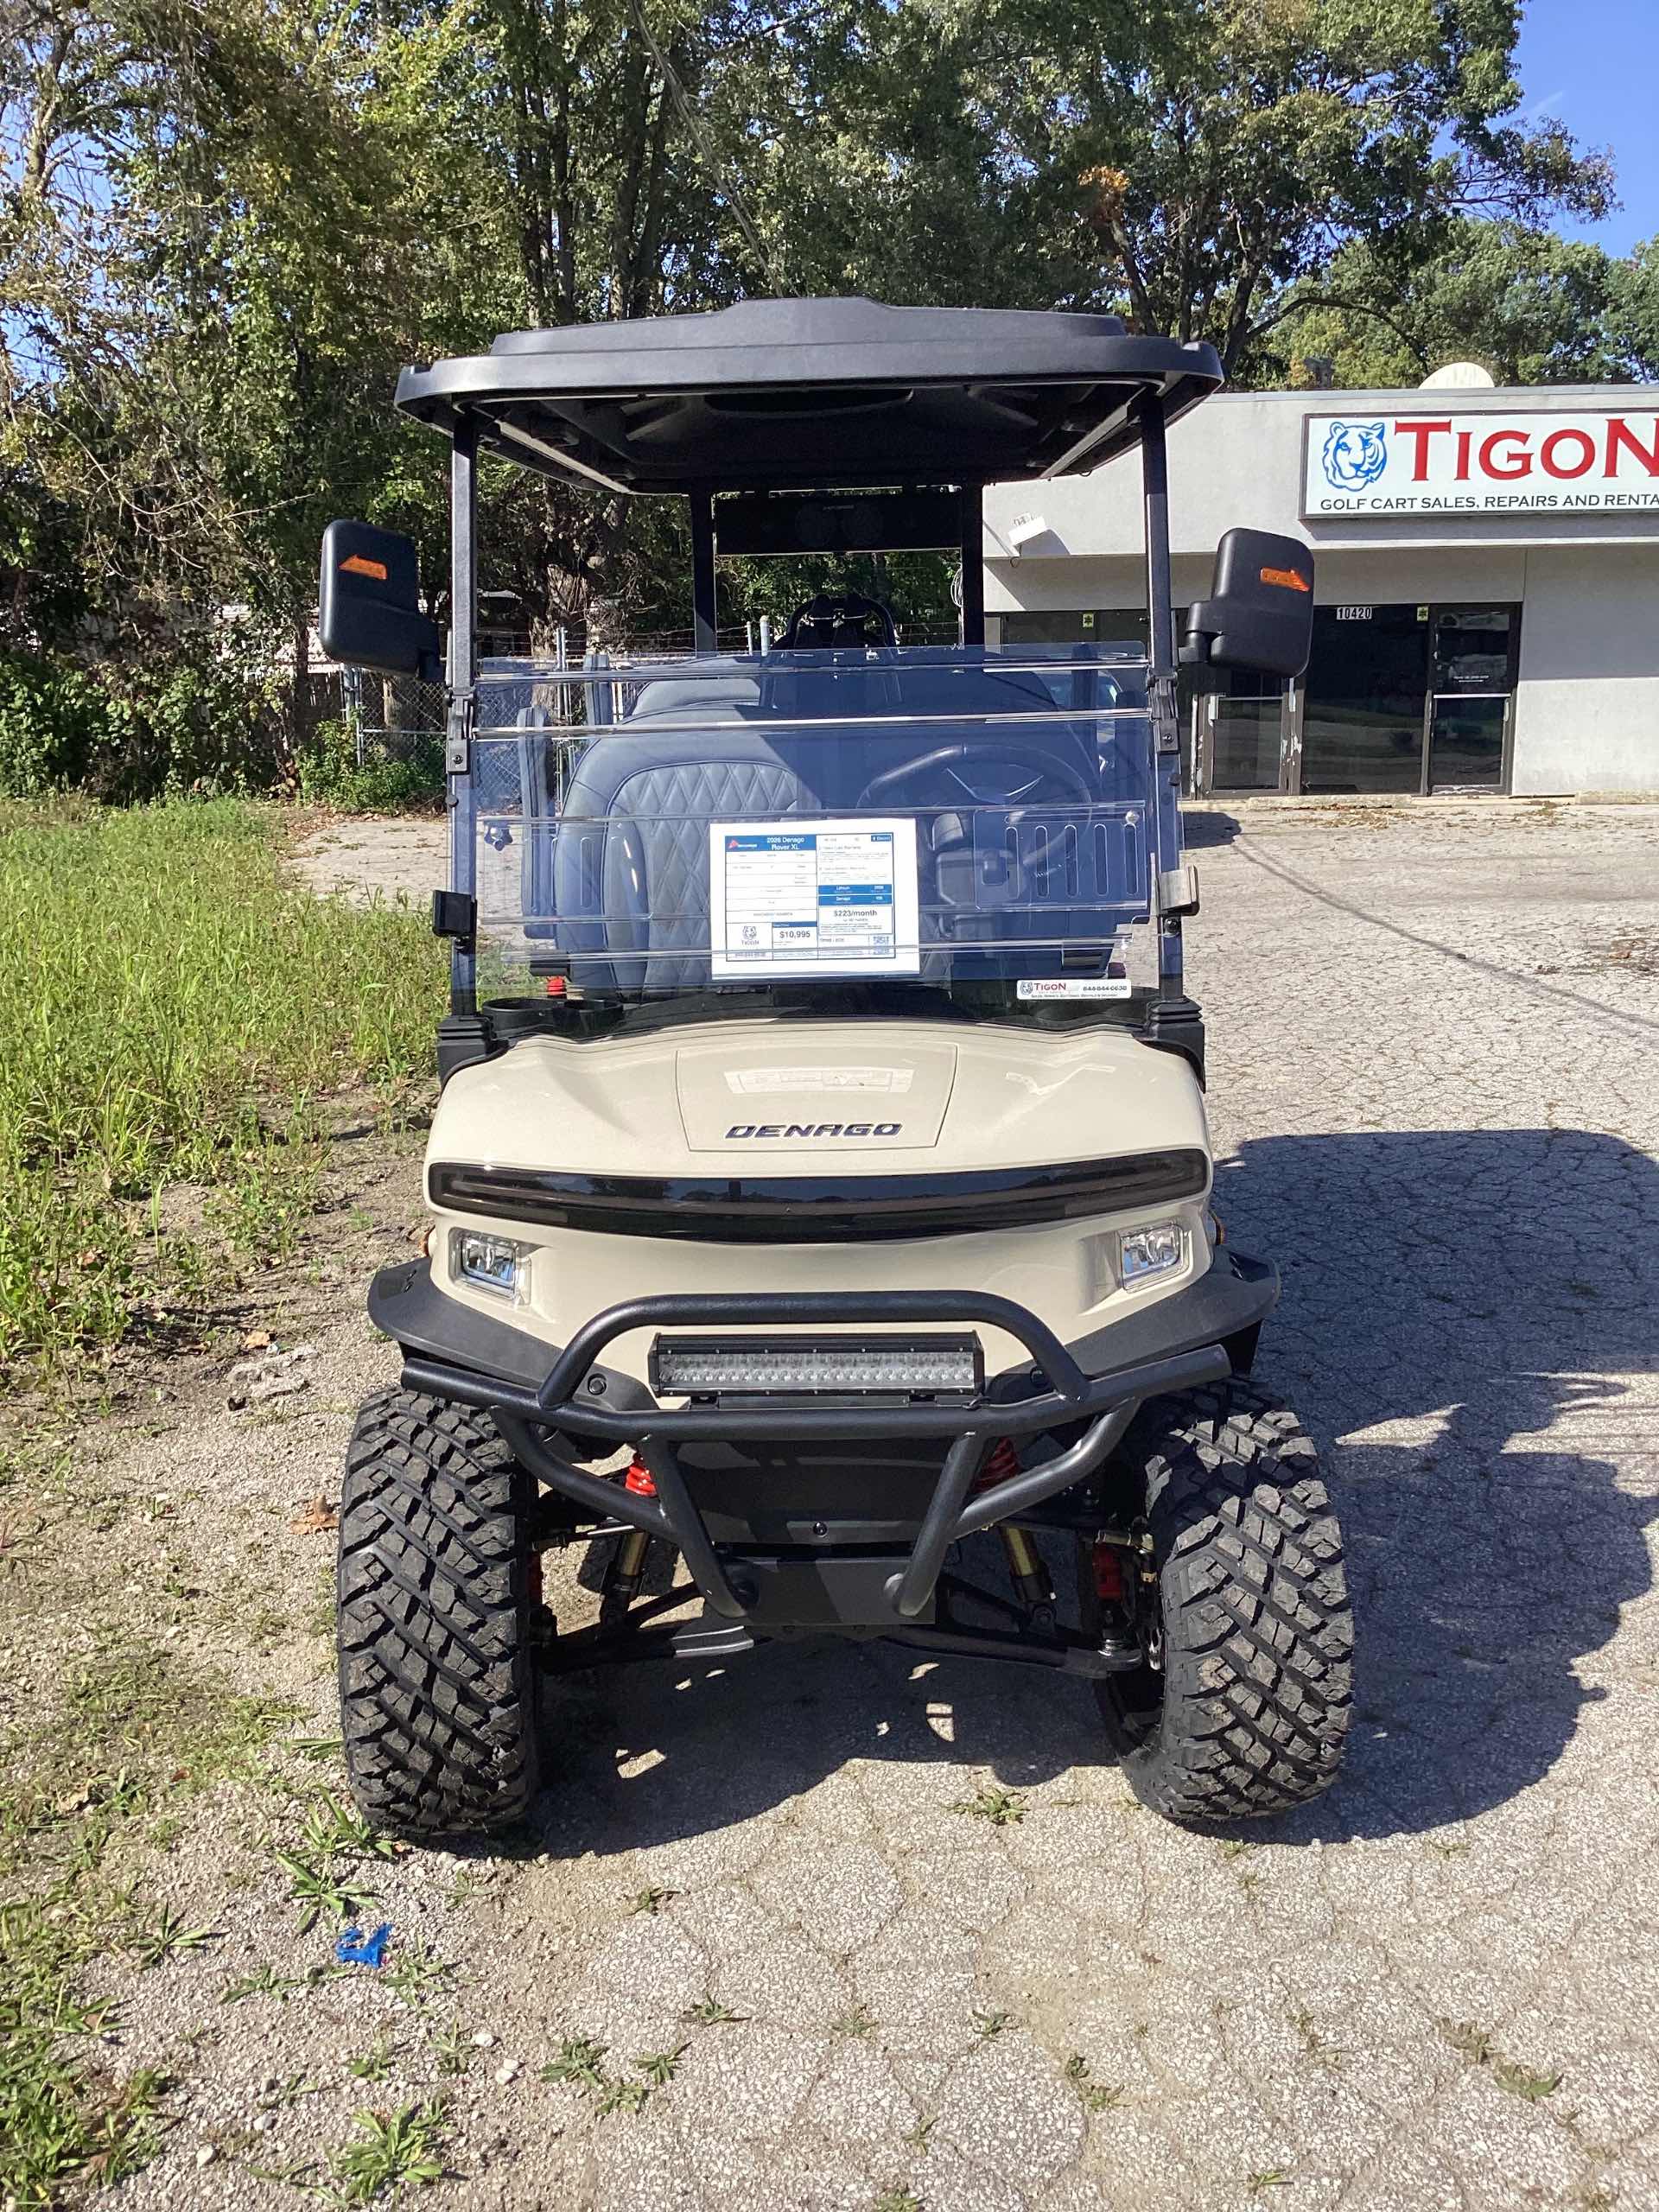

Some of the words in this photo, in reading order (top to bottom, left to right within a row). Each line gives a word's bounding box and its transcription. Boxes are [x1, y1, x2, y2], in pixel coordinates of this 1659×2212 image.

[1394, 418, 1659, 482] TIGON
[1320, 498, 1368, 511] GOLF
[1370, 497, 1418, 510] CART
[1421, 496, 1480, 510] SALES,
[1484, 495, 1557, 508] REPAIRS
[1563, 494, 1600, 506] AND
[1338, 607, 1371, 620] 10420
[779, 931, 810, 939] $10,995
[1034, 982, 1066, 991] TIGON
[725, 1123, 903, 1139] DENAGO
